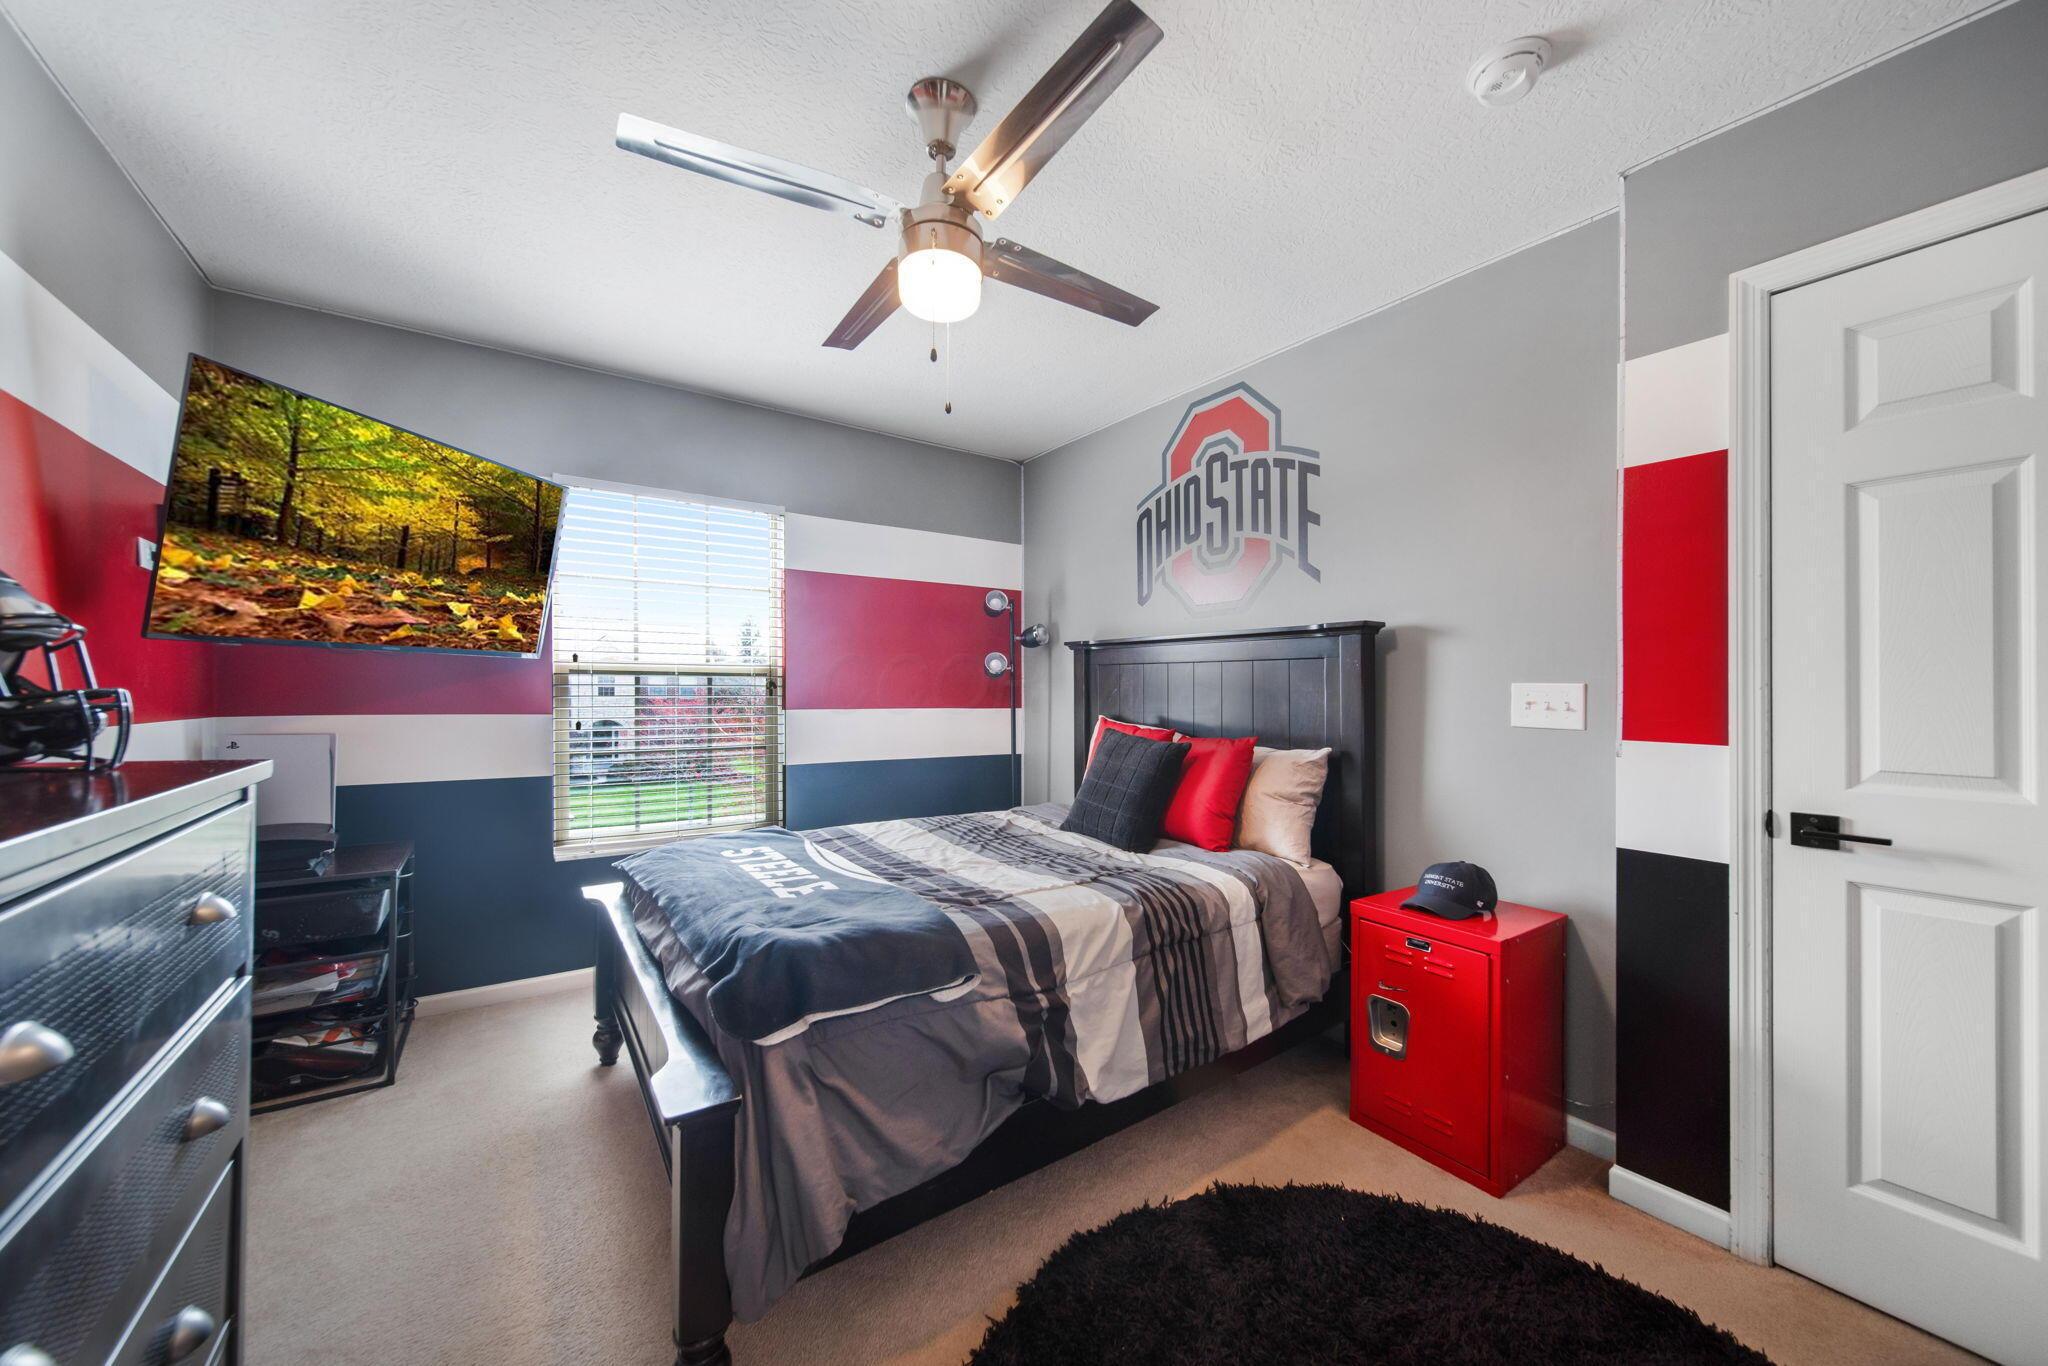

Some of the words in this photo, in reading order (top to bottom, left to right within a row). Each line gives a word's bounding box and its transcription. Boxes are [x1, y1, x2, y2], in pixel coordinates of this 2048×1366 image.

[1137, 474, 1201, 606] OHIO
[1205, 450, 1321, 584] STATE
[720, 846, 839, 898] STEELE
[1444, 877, 1464, 888] STATE
